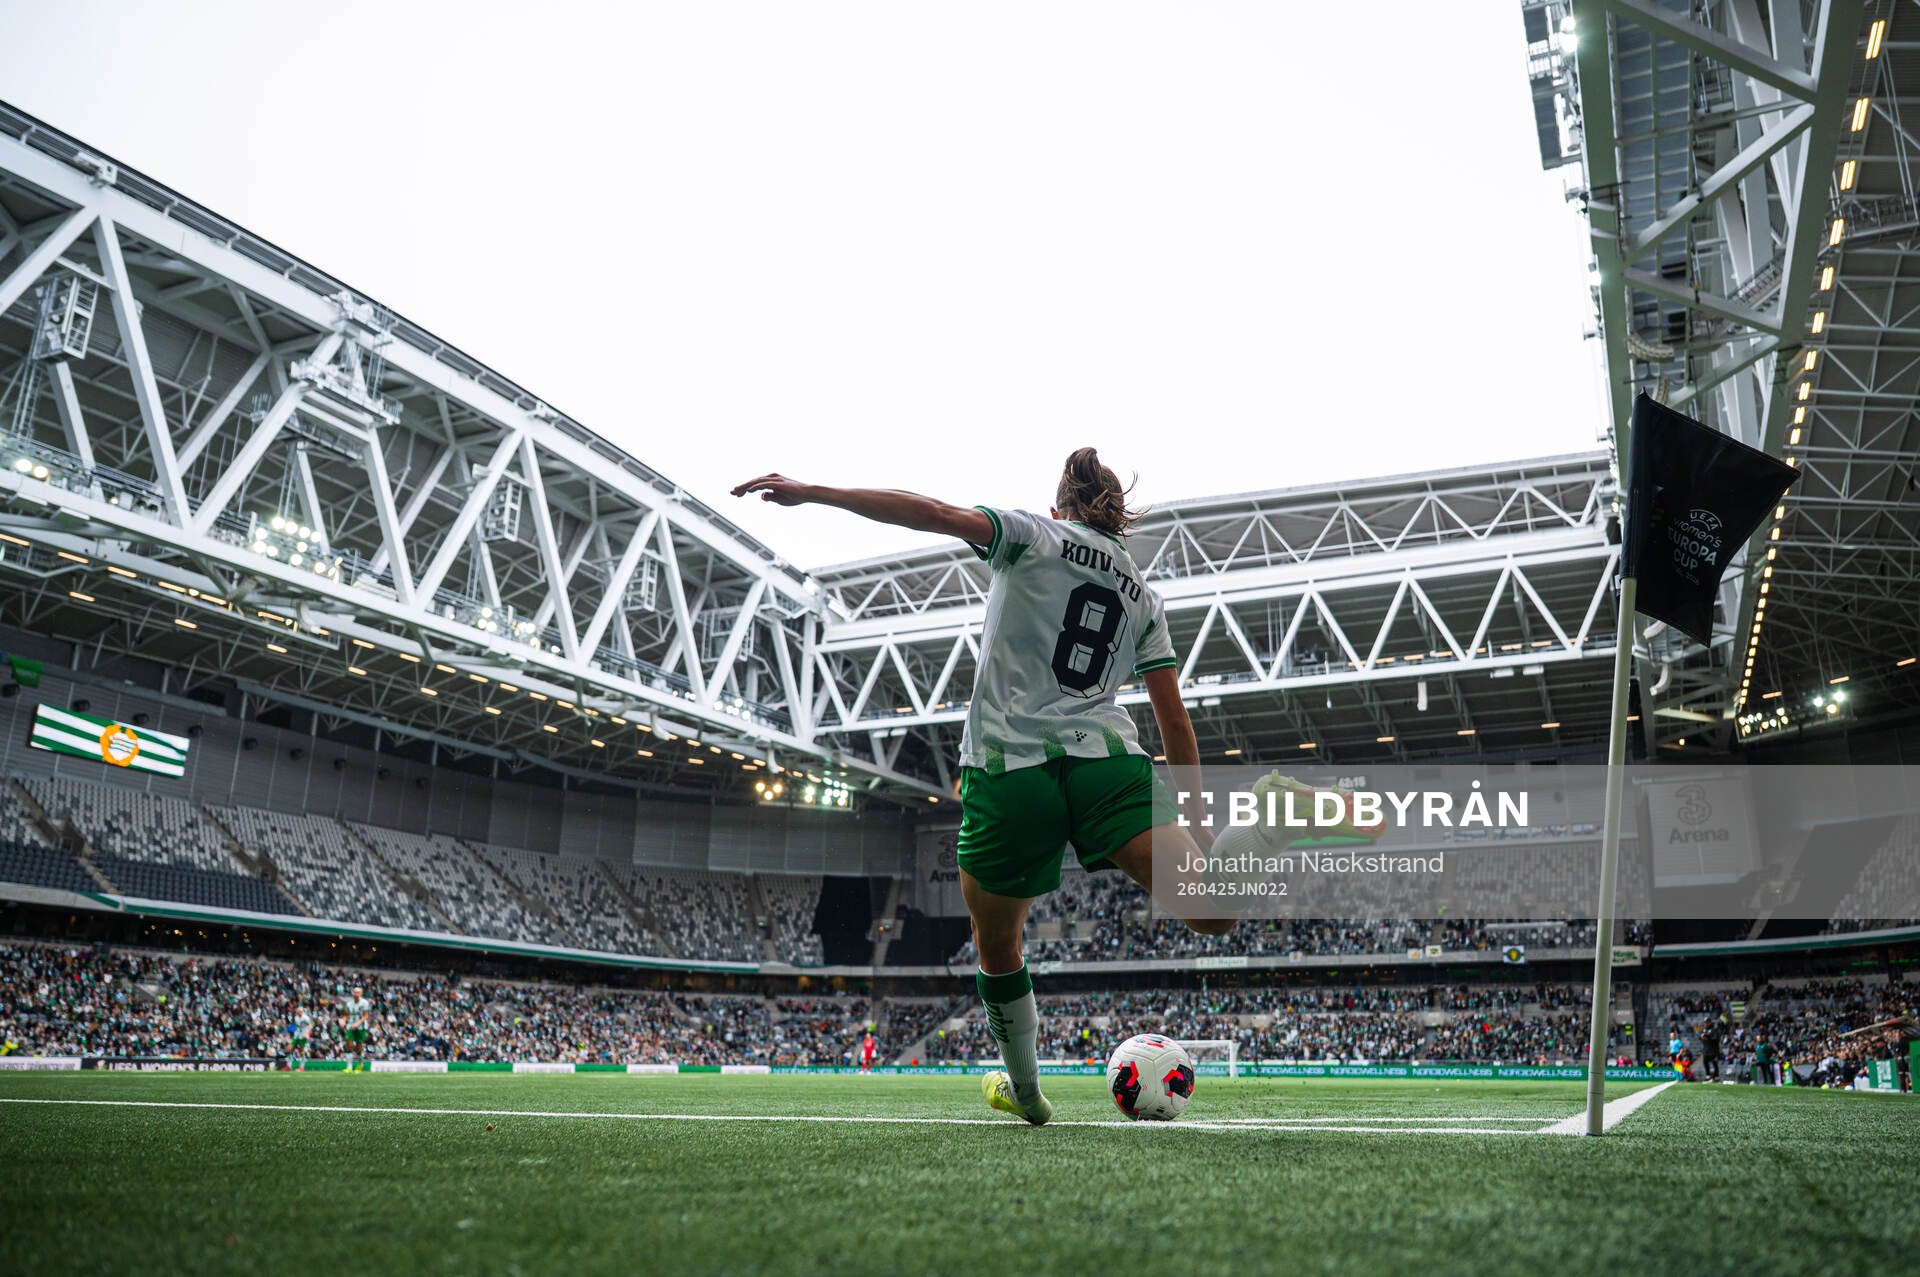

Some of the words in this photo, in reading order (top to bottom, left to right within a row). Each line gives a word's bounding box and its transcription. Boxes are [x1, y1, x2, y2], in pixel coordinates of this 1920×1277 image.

[1690, 511, 1719, 530] UEFA
[1673, 548, 1698, 570] CUP
[1060, 539, 1142, 603] KOIVTO
[1051, 581, 1129, 698] 8
[1668, 828, 1729, 844] Arena
[929, 869, 960, 882] Aren
[141, 1063, 195, 1071] WOMEN'S
